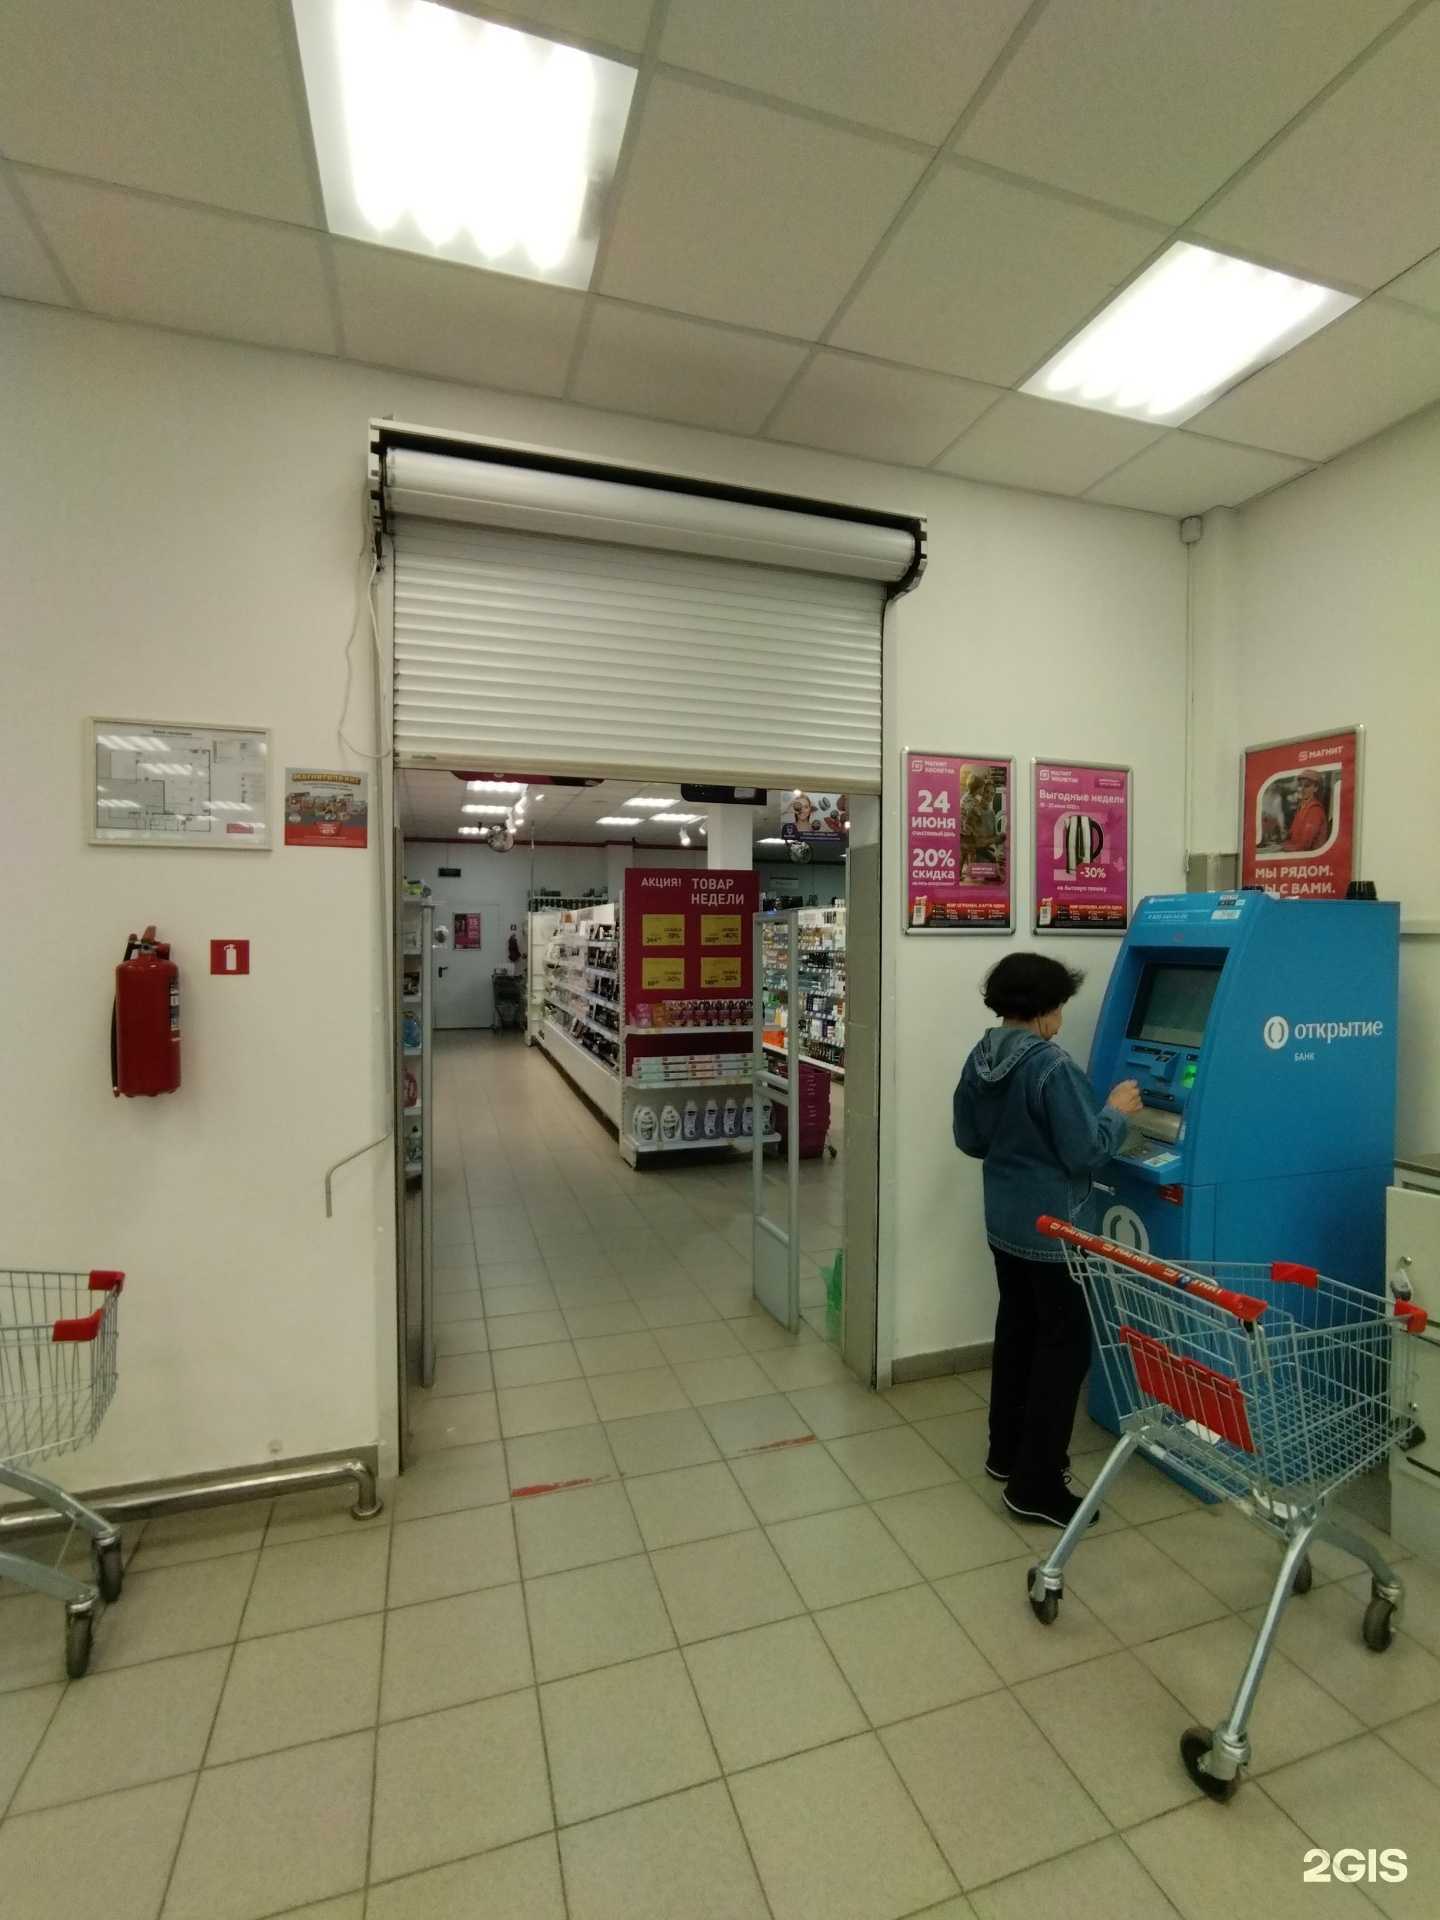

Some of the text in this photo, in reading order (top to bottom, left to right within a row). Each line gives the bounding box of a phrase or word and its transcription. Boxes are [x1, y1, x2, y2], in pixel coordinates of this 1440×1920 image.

[1308, 746, 1344, 759] МАГНИТ
[917, 789, 951, 814] 24
[1039, 789, 1089, 802] Выгодные
[911, 816, 956, 829] ИЮНЯ
[912, 848, 956, 867] 20%
[912, 869, 955, 880] скидка
[1080, 867, 1106, 879] -30%
[1255, 865, 1334, 879] МЫ РЯДОМ.
[641, 877, 734, 890] АКЦИЯ! ТОВАР
[1255, 882, 1336, 895] Ы С ВАМИ.
[691, 893, 744, 906] НЕДЕЛИ
[1294, 1020, 1384, 1044] открытие
[1294, 1052, 1315, 1062] БАНК
